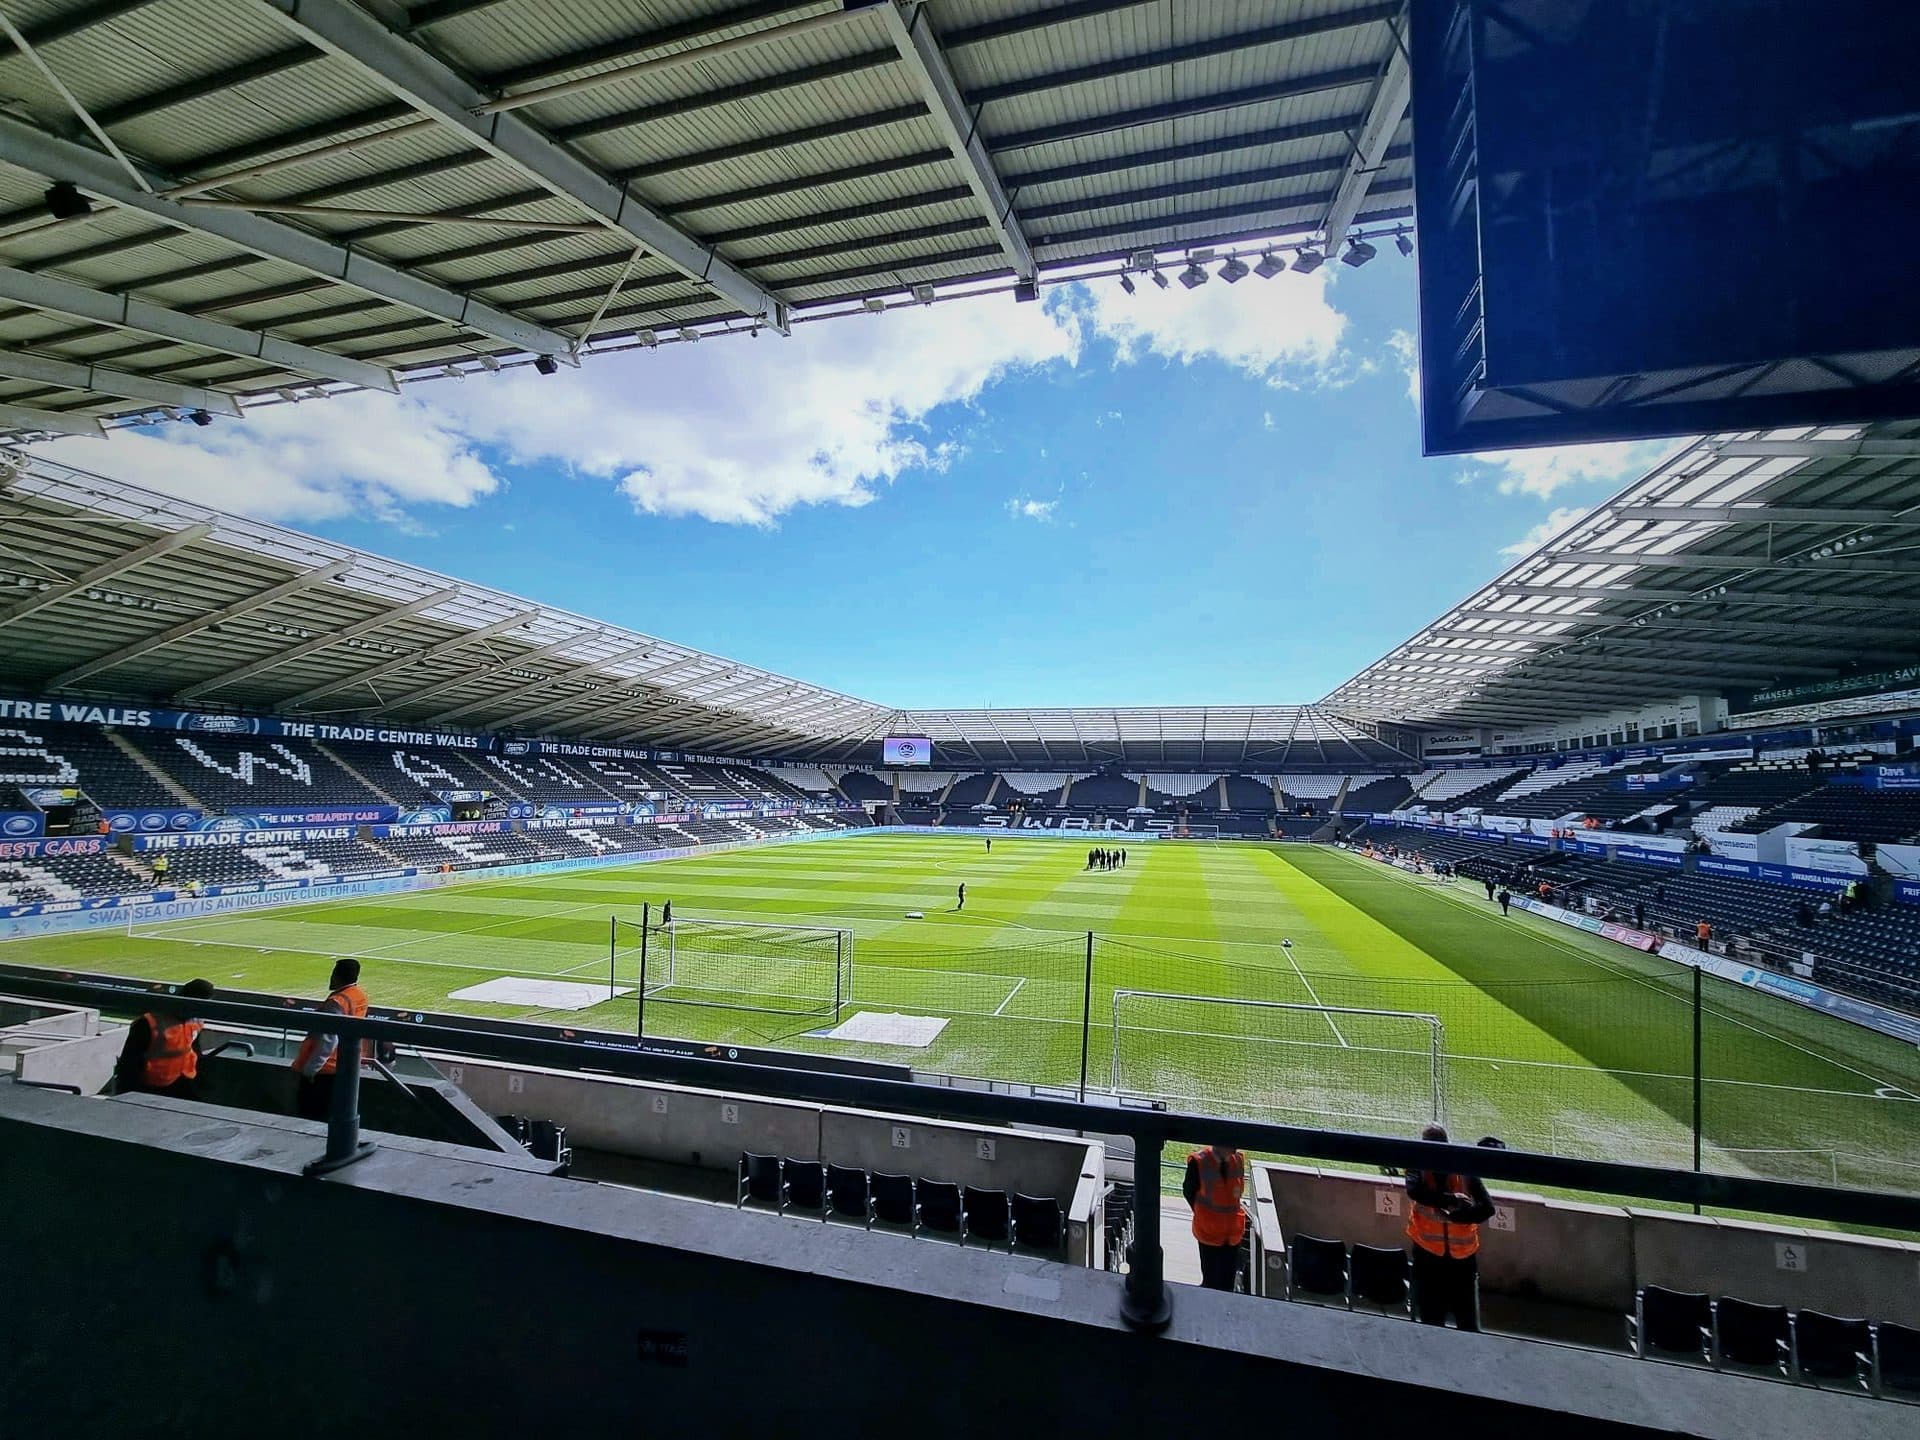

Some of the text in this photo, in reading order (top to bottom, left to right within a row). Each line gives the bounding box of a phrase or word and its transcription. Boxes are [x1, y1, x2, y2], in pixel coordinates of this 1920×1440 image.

[1753, 688, 1794, 702] SWANSEA
[60, 704, 152, 727] WALES
[280, 722, 478, 748] THE TRADE CENTRE WALES
[540, 742, 559, 754] THE
[560, 744, 590, 756] TRADE
[591, 748, 622, 758] CENTRE
[623, 749, 648, 760] WALES
[684, 754, 696, 763] THE
[696, 755, 715, 764] TRADE
[716, 757, 735, 765] CENTRE
[783, 761, 873, 772] THE TRADE CENTRE WALES
[280, 813, 304, 823] UK'S
[526, 820, 541, 829] THE
[542, 819, 566, 828] TRADE
[389, 826, 407, 837] THE
[409, 825, 431, 836] UK'S
[144, 828, 350, 849] THE TRADE CENTRE WALES
[44, 839, 101, 855] CARS
[1791, 872, 1822, 883] SWANSEA
[88, 905, 162, 924] SWANSEA
[166, 901, 197, 916] CITY
[201, 900, 213, 911] IS
[216, 897, 234, 909] AN
[237, 888, 298, 906] INCLUSIVE
[300, 886, 328, 899] CLUB
[329, 885, 349, 896] FOR
[351, 882, 368, 893] ALL
